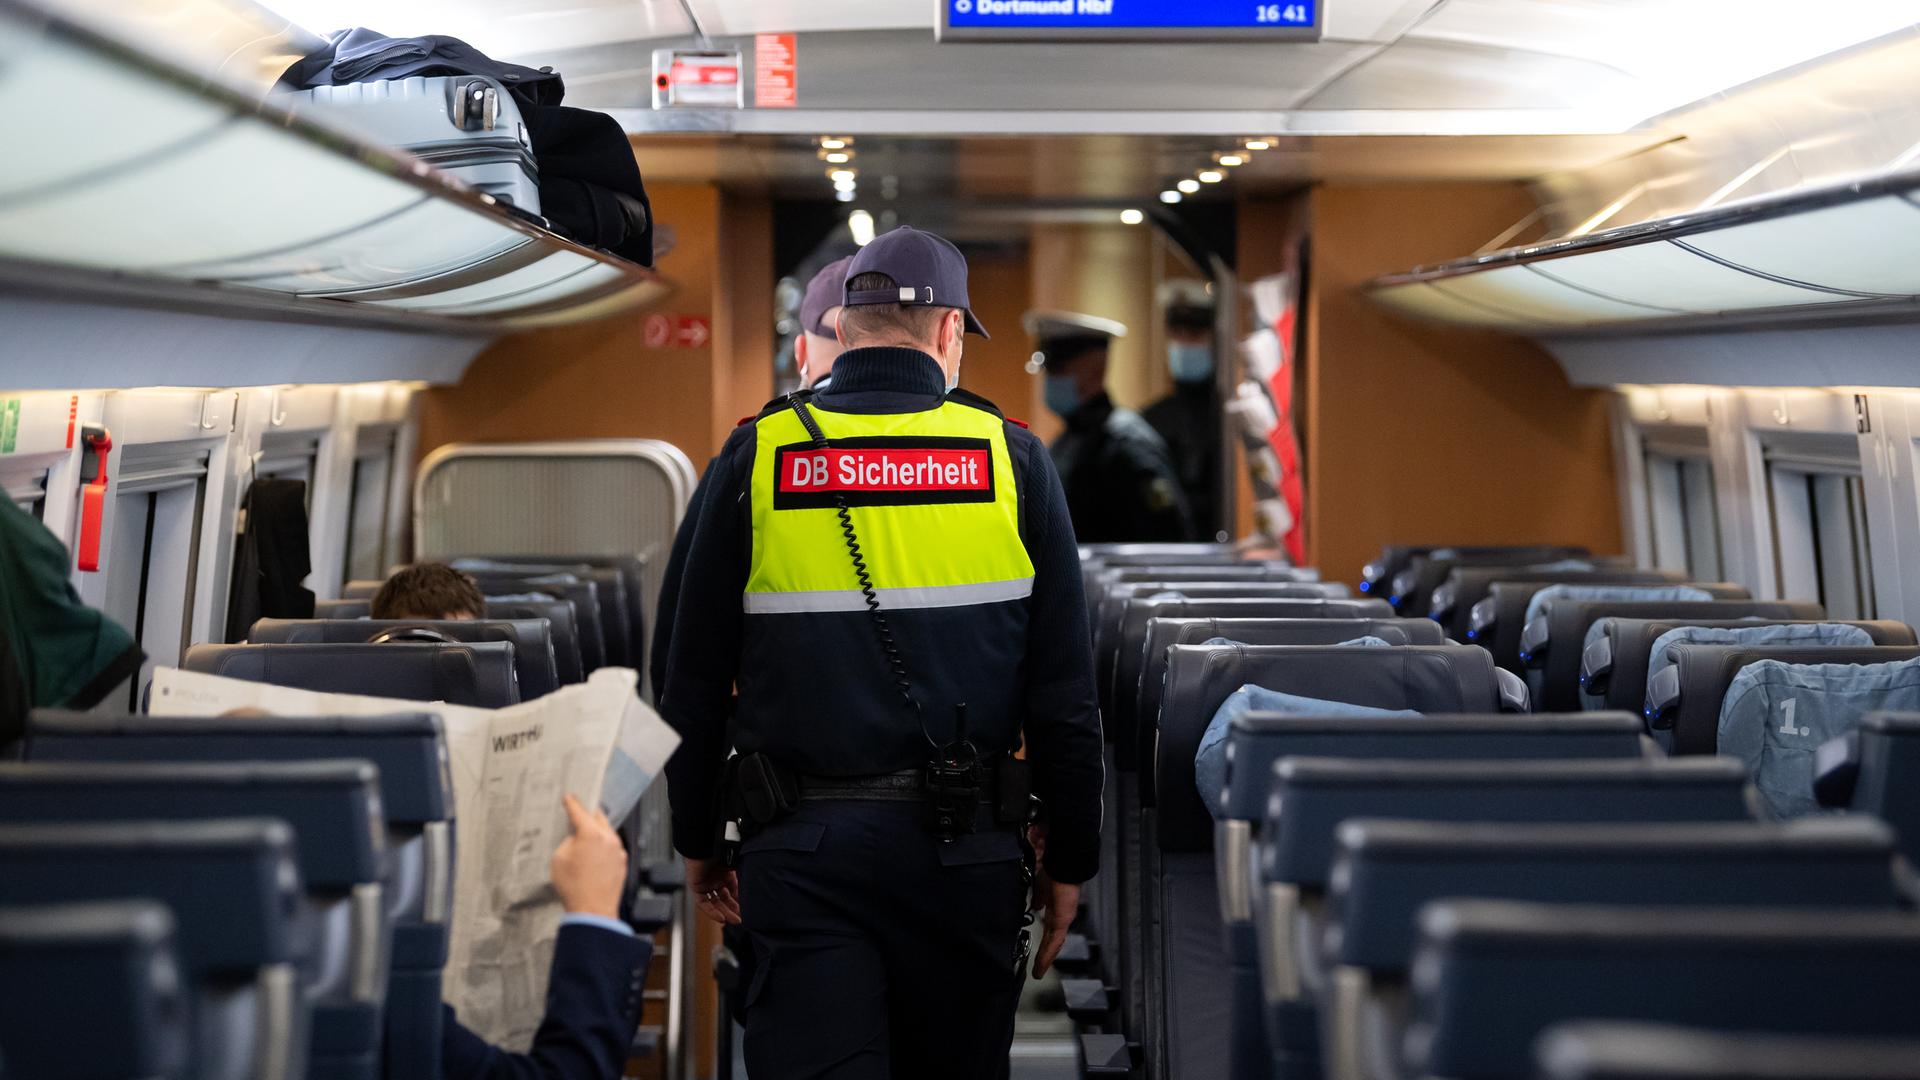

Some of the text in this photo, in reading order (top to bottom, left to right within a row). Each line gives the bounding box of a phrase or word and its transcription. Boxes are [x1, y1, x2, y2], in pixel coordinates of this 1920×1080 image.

[977, 0, 1114, 15] Dortmund Hbf
[1256, 4, 1307, 22] 16 41
[792, 455, 978, 486] DB Sicherheit
[1779, 697, 1810, 737] 1.
